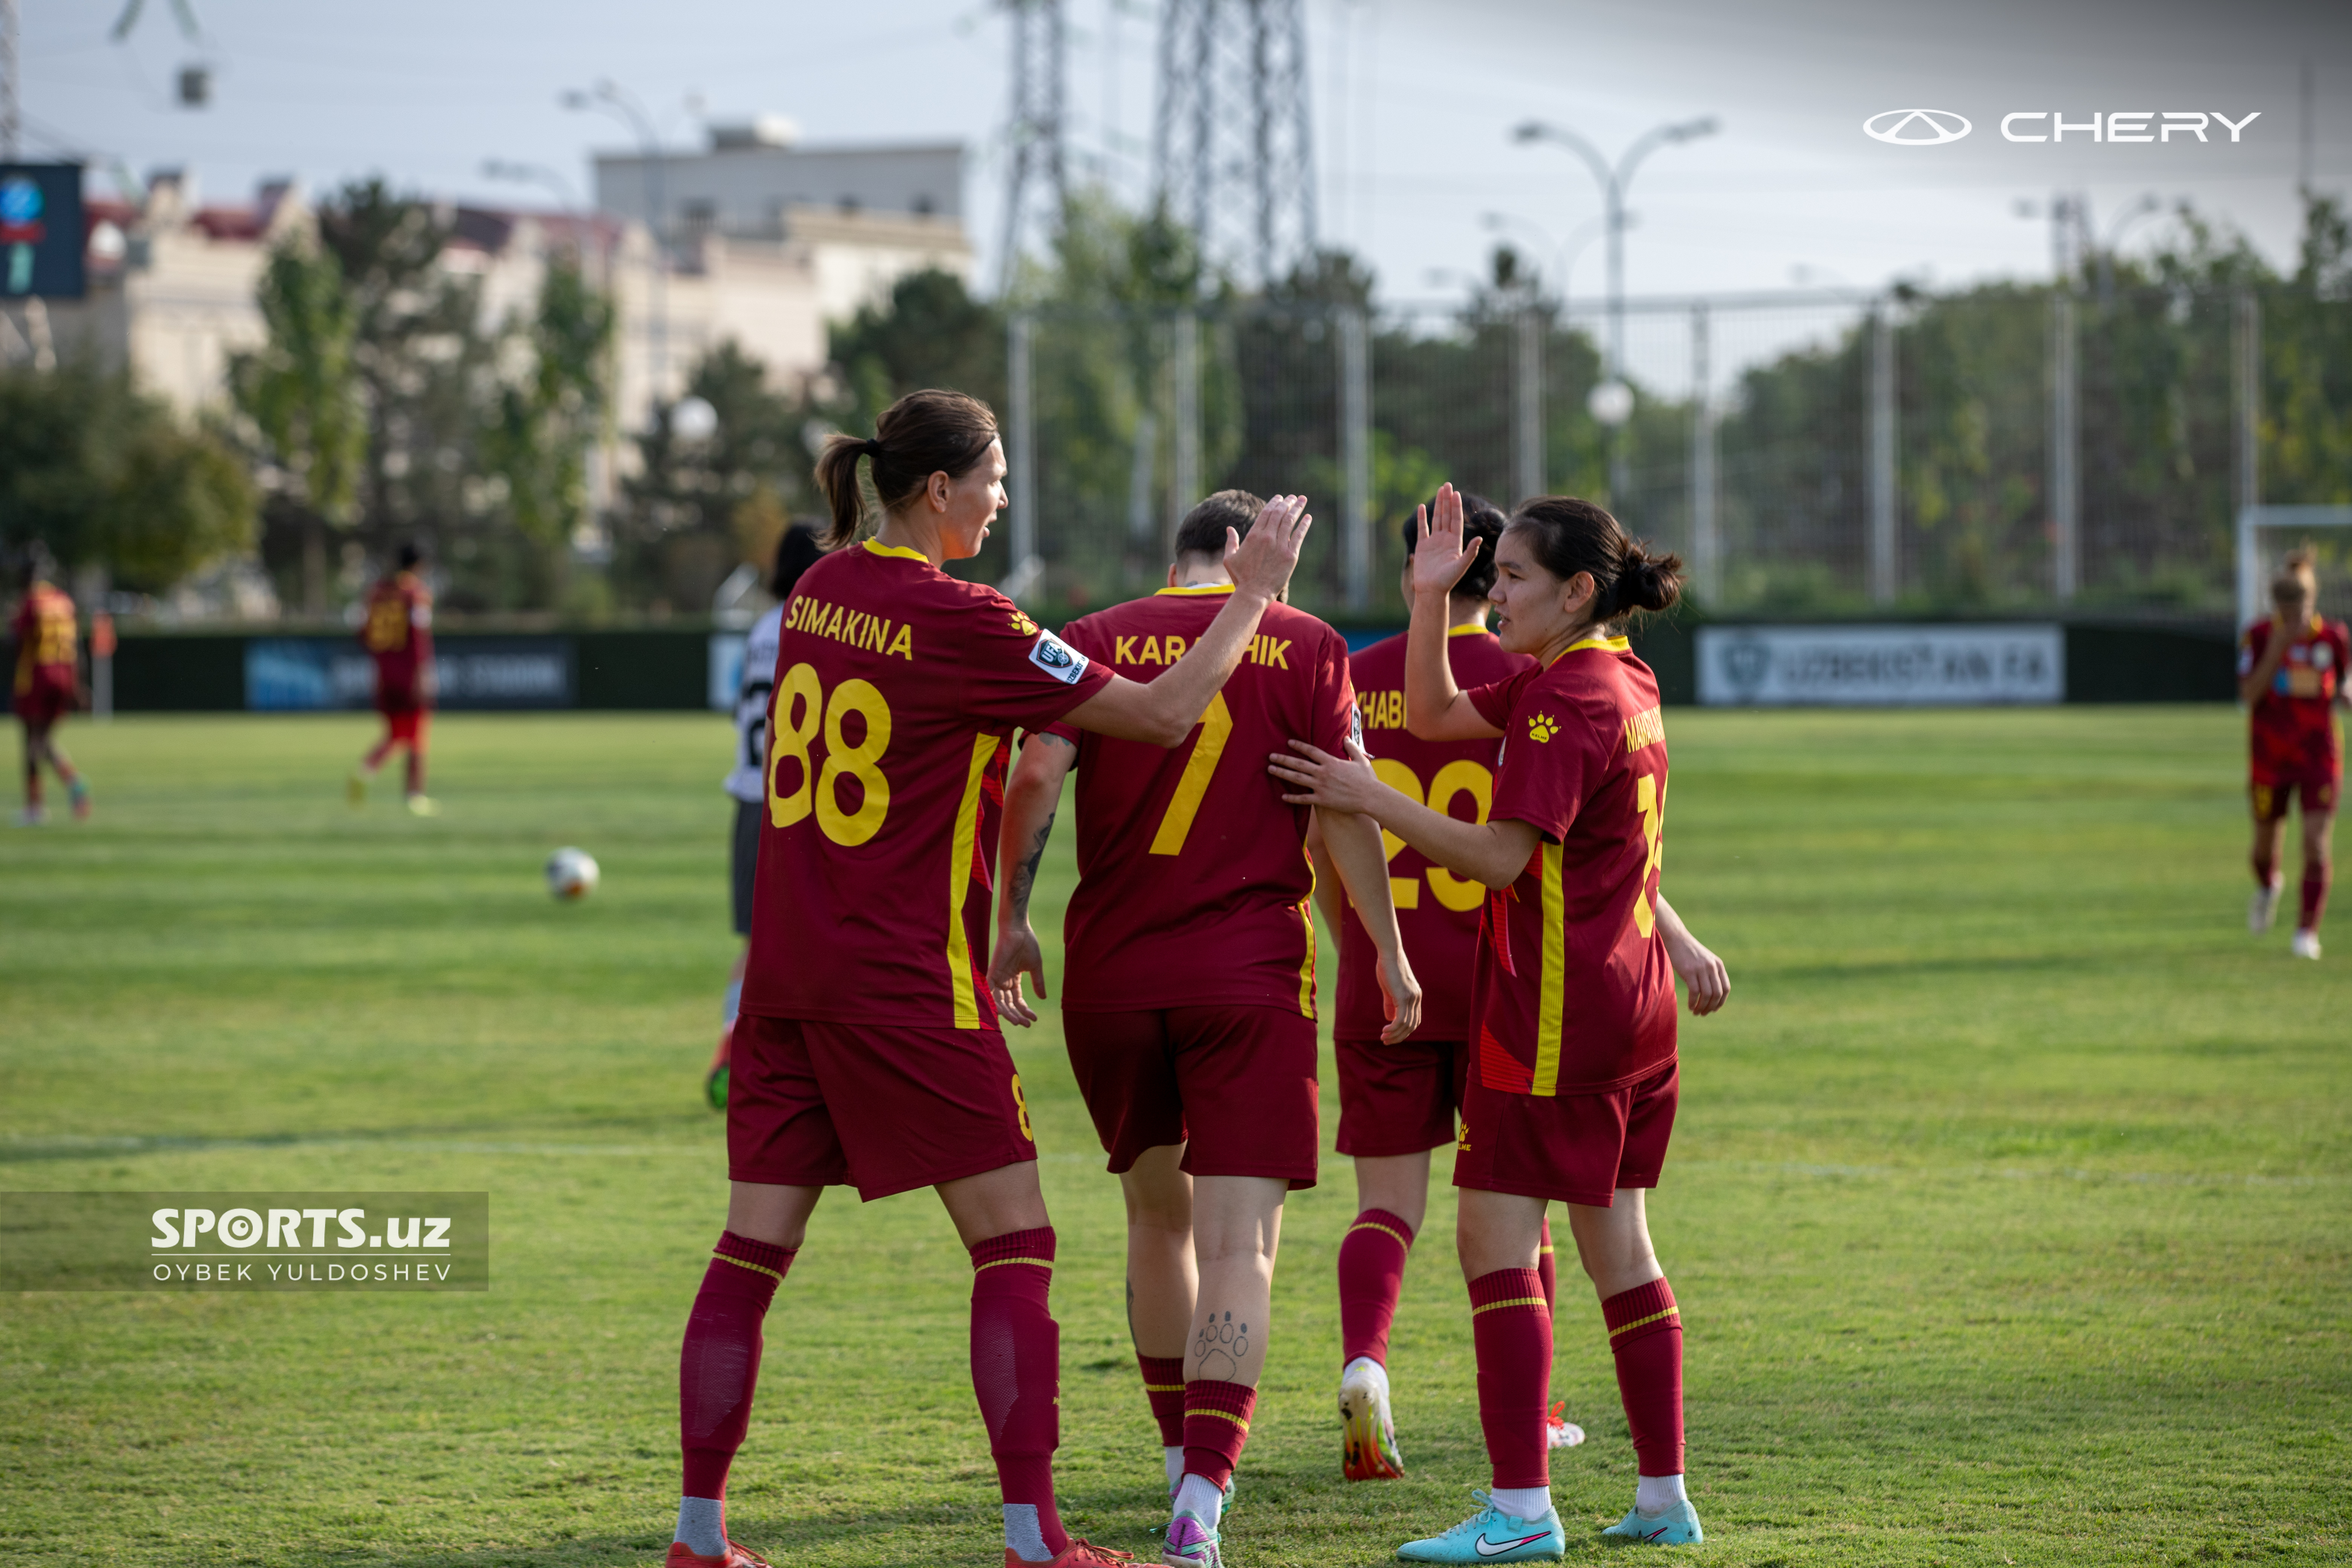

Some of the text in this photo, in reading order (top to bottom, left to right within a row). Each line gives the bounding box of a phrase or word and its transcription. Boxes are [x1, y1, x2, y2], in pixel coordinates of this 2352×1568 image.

[785, 595, 913, 661] SIMAKINA
[1041, 642, 1062, 663] UFA
[1115, 635, 1292, 670] KARHIK
[769, 662, 892, 847] 88
[1350, 758, 1493, 912] 29
